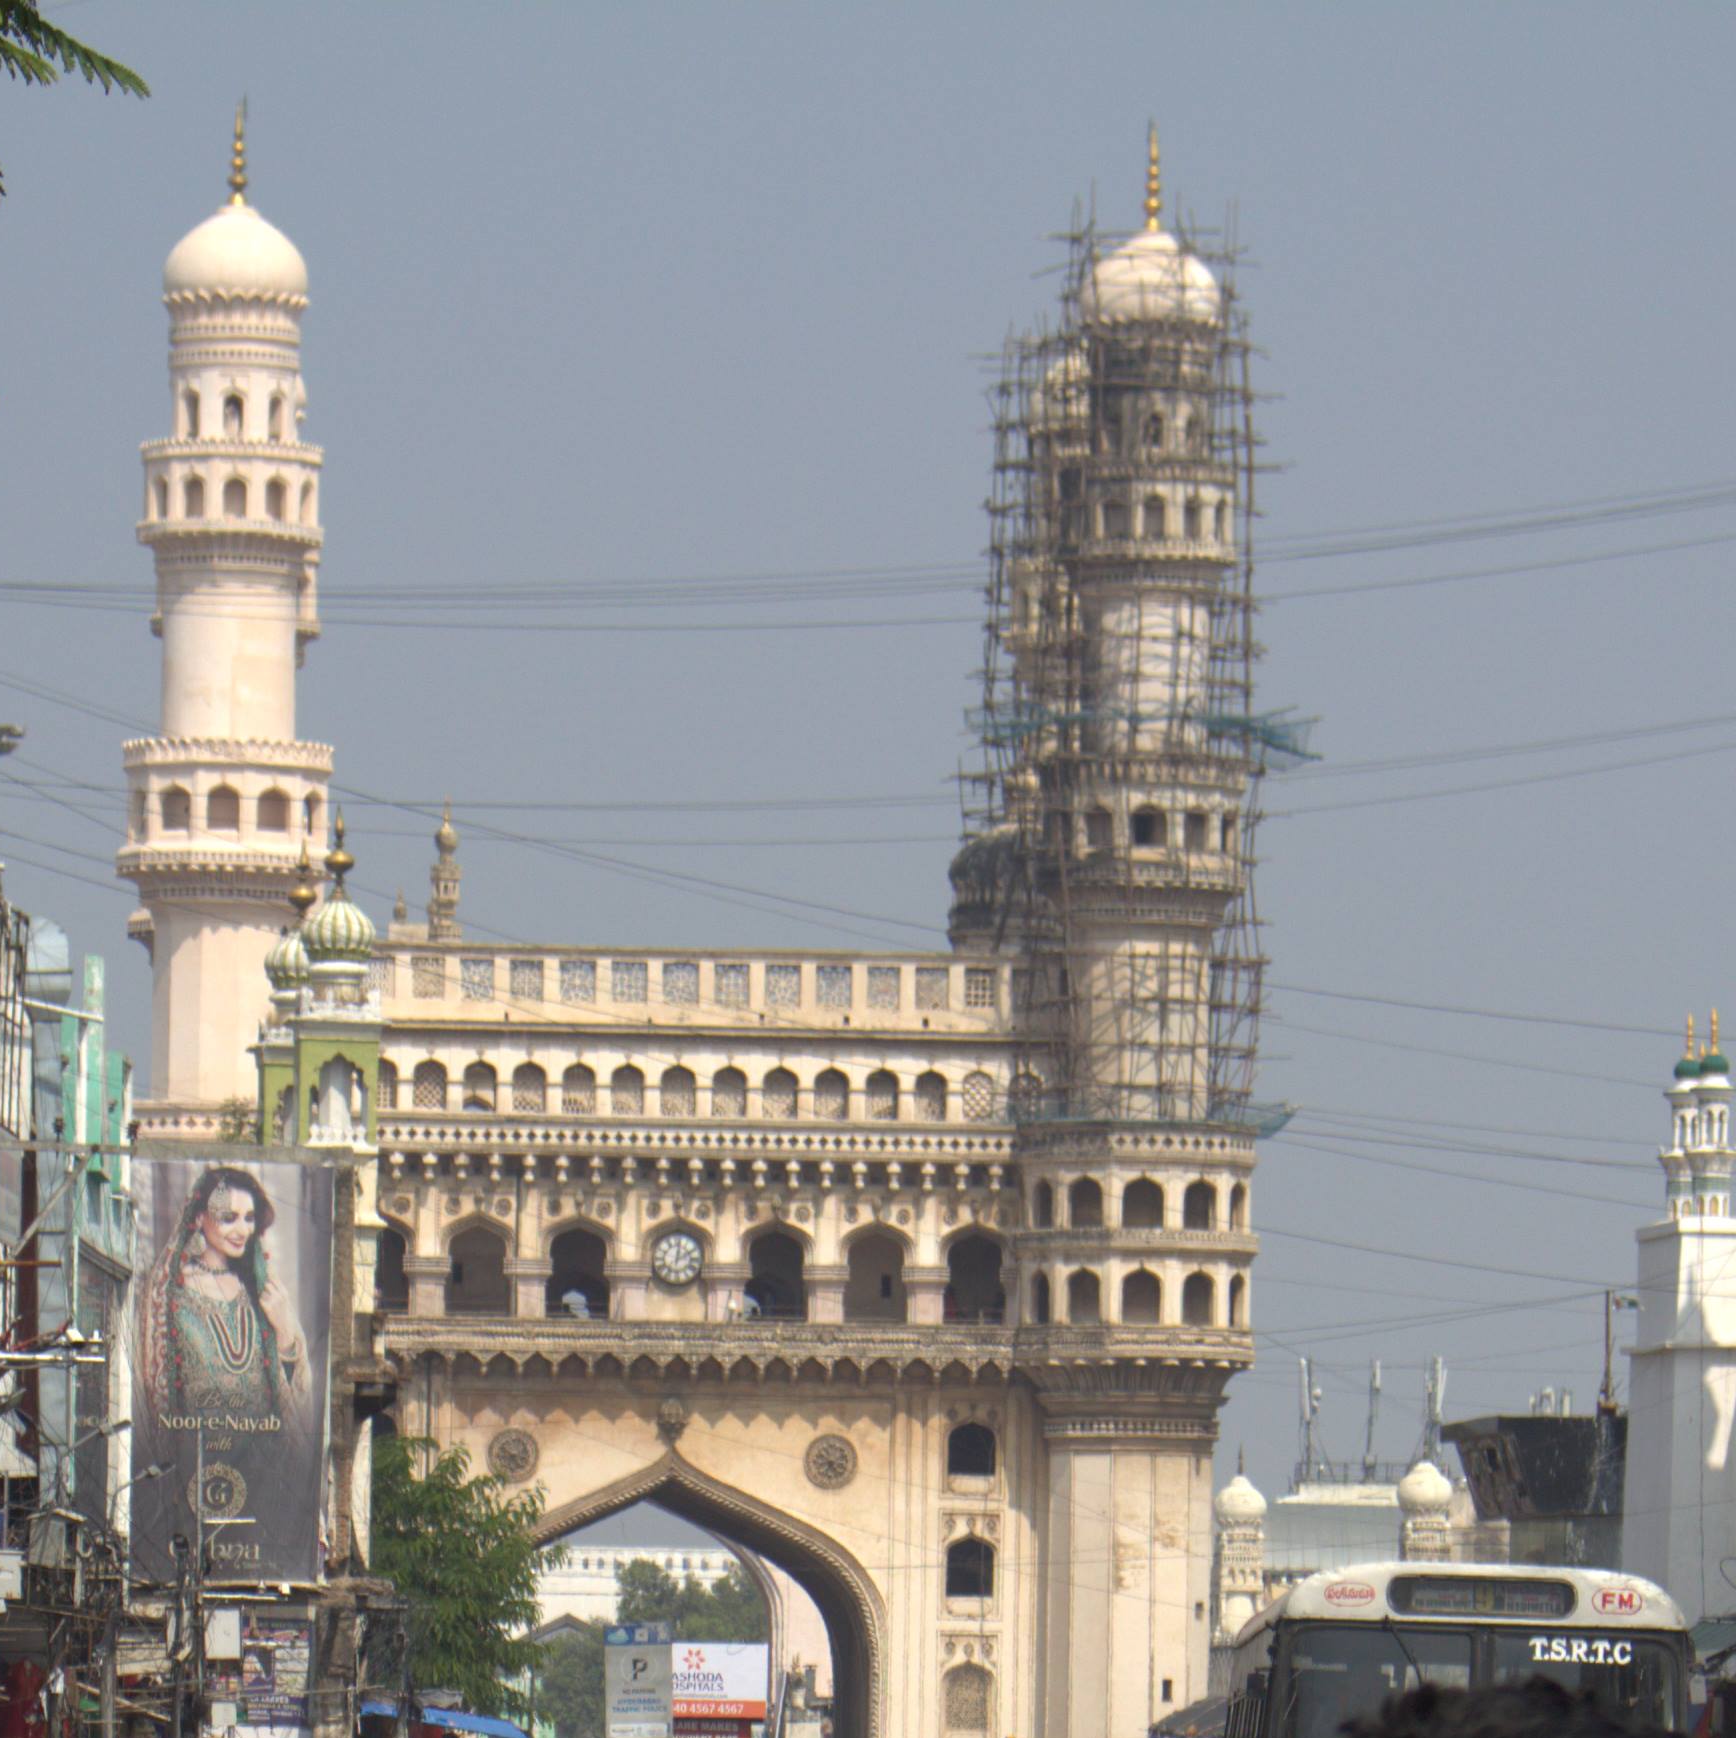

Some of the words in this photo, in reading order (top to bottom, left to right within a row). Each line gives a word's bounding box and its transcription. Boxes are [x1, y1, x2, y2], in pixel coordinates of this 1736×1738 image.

[158, 1413, 281, 1433] Noor-e-Nayab
[1601, 1592, 1635, 1610] FM
[672, 1672, 724, 1682] ASHODA
[690, 1704, 714, 1714] 4567
[718, 1704, 744, 1714] 4567
